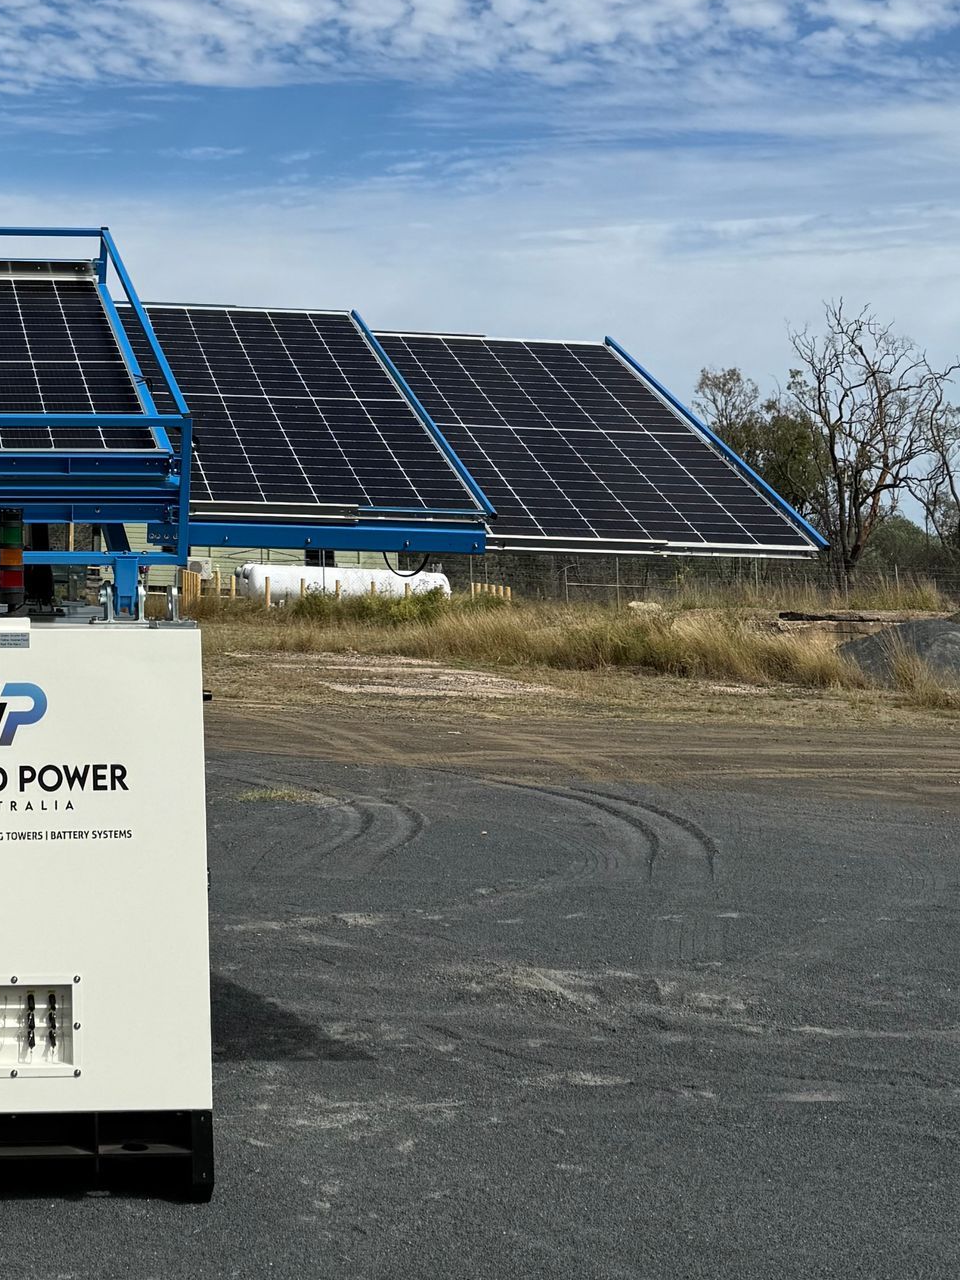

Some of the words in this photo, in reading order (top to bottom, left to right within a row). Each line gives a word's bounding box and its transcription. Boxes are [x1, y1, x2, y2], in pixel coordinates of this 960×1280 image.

[18, 763, 130, 793] POWER
[5, 831, 44, 841] TOWERS
[50, 830, 90, 841] BATTERY
[91, 829, 133, 840] SYSTEMS
